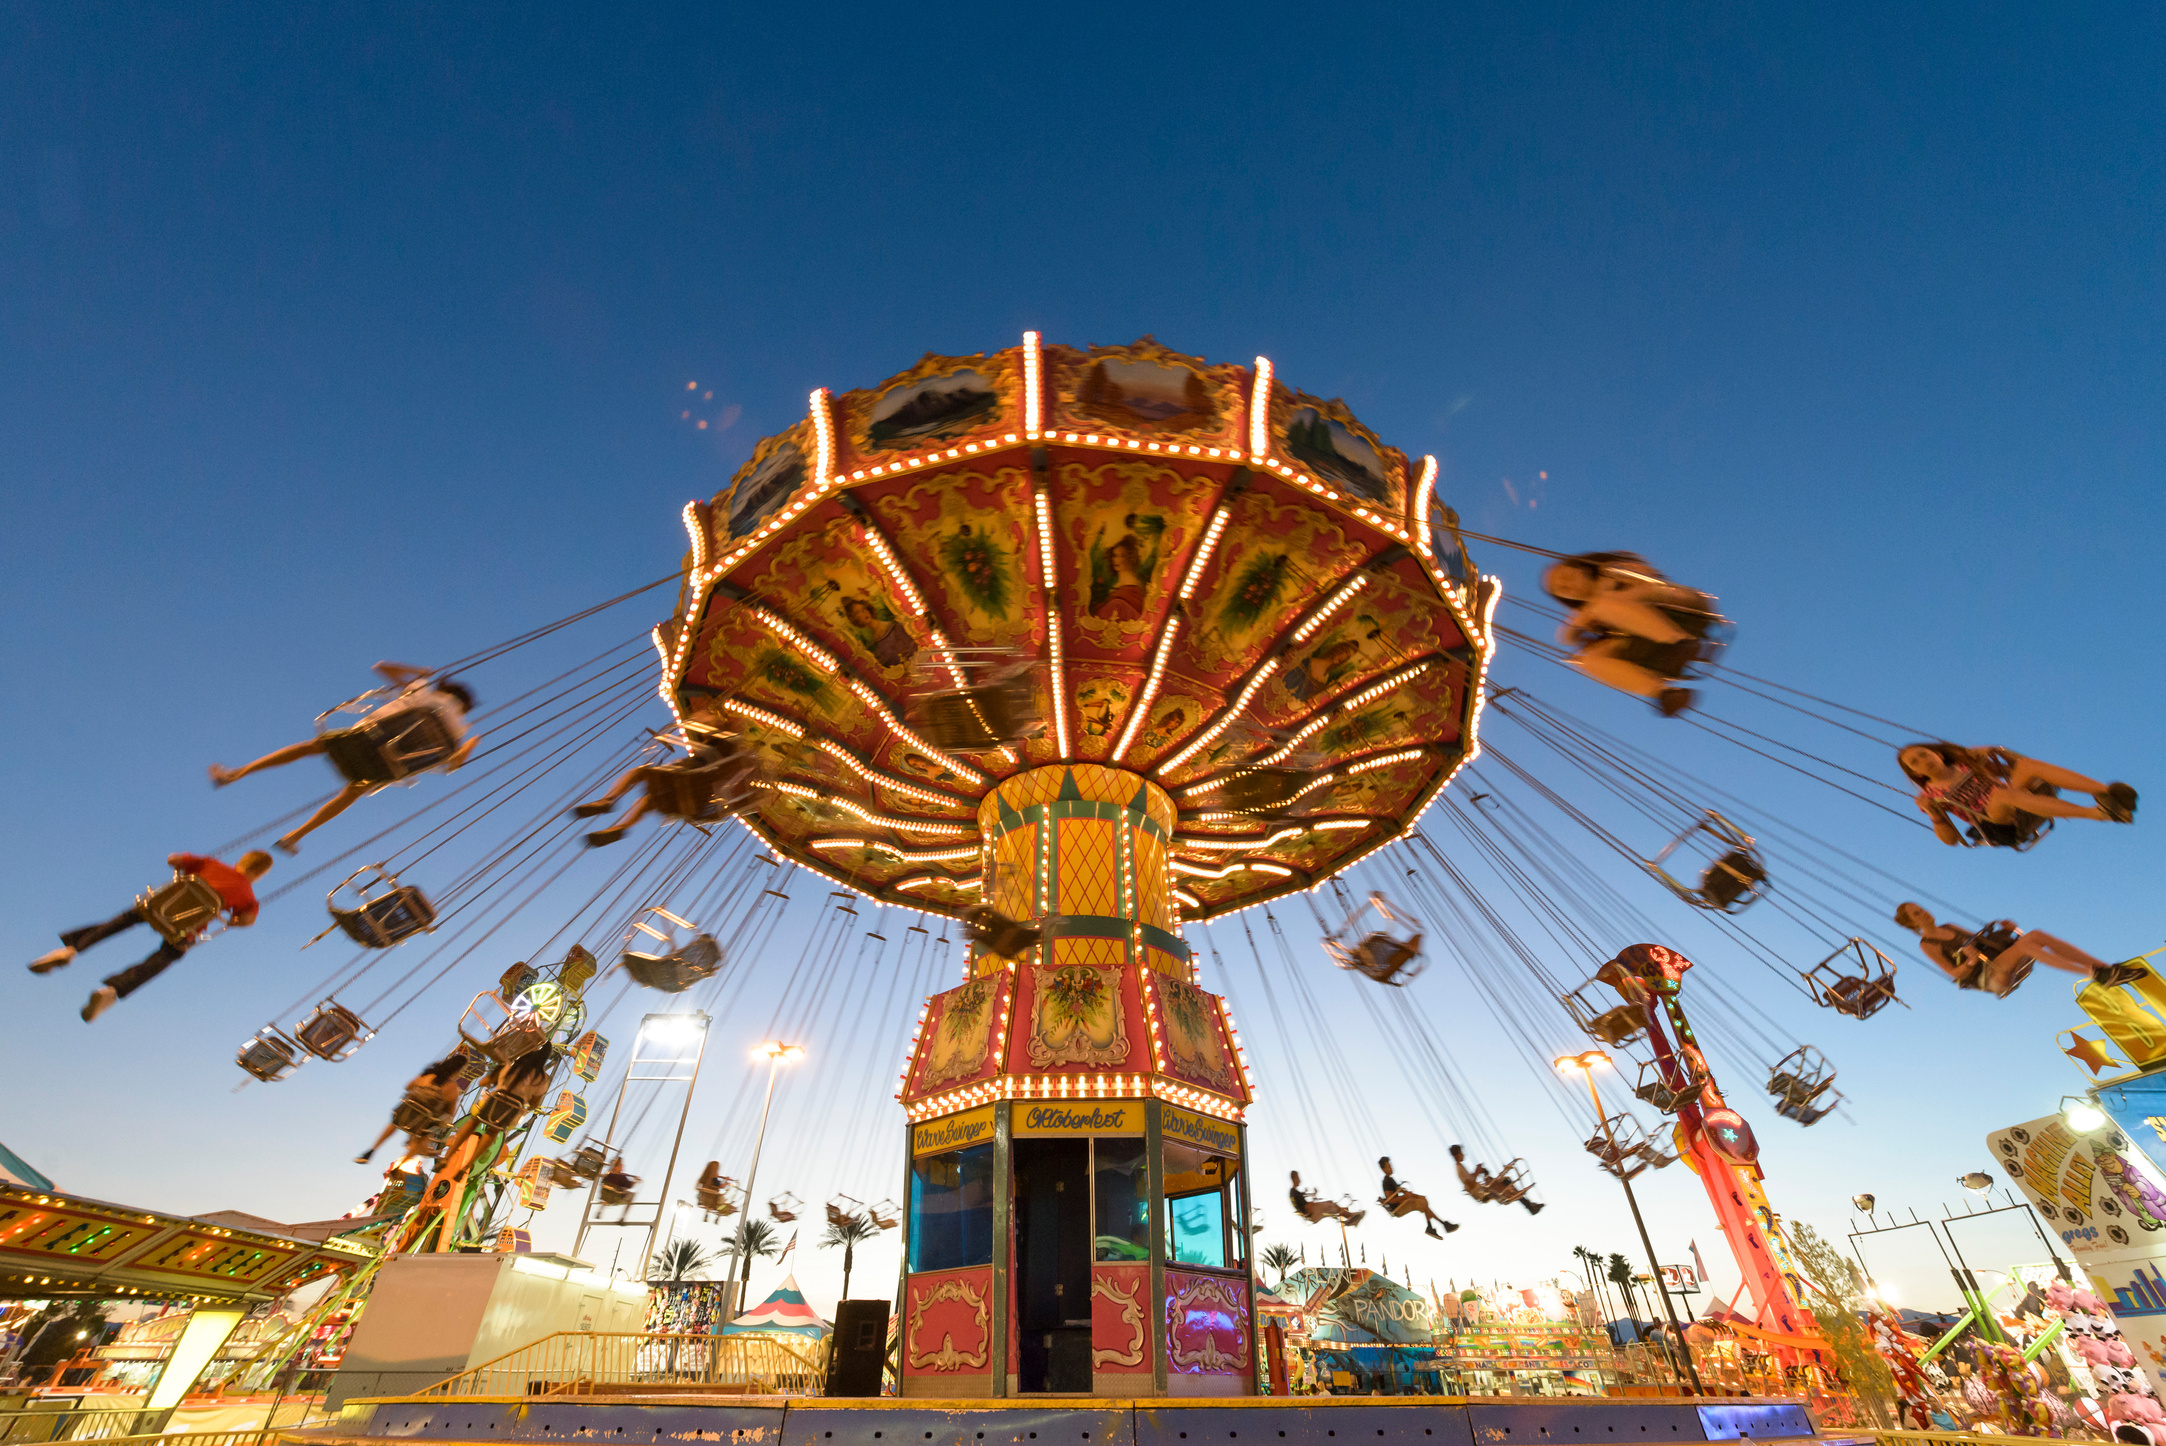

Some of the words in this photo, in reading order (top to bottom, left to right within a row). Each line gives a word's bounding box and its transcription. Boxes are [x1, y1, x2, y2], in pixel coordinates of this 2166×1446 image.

[2023, 1121, 2078, 1208] MACHINE
[2060, 1150, 2096, 1220] ALLEY
[2061, 1226, 2099, 1245] gregs
[1305, 1267, 1368, 1284] PLANET
[1475, 1360, 1508, 1369] NACHOS
